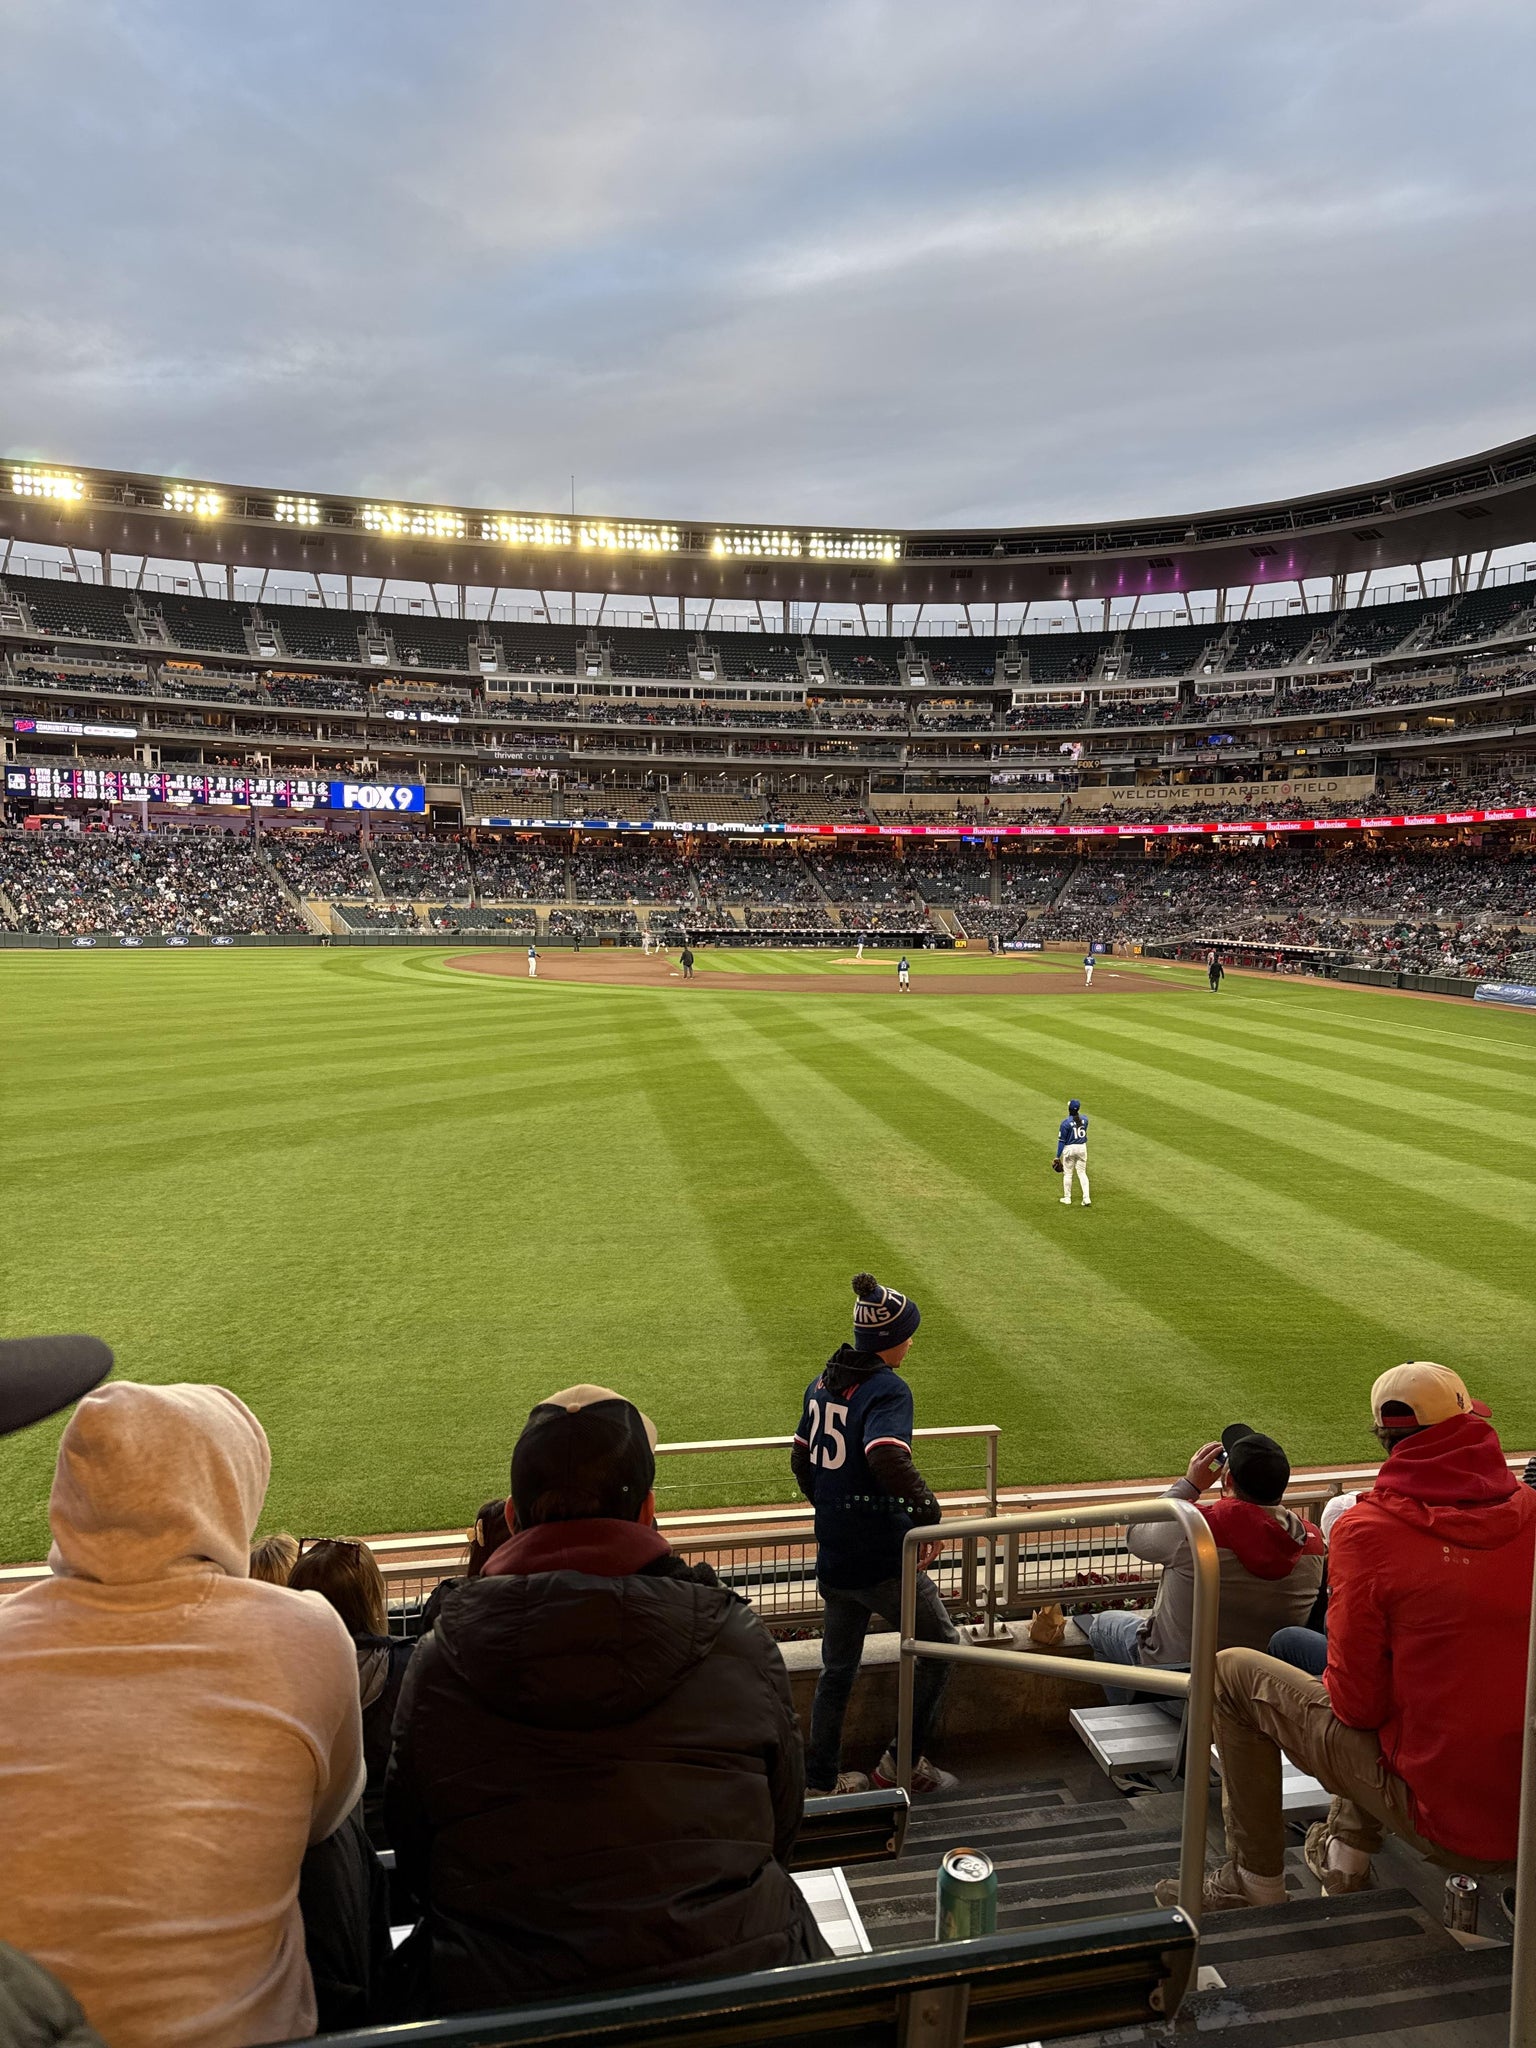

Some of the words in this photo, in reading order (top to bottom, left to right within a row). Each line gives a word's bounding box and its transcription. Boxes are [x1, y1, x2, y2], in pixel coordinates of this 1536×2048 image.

[36, 723, 67, 732] COMMUNITY
[68, 725, 82, 733] FUND
[494, 751, 523, 760] thrivent
[1078, 760, 1094, 768] FOX
[1094, 760, 1100, 768] 9
[1112, 788, 1190, 799] WELCOME
[1195, 787, 1214, 797] TO
[1218, 785, 1279, 796] TARGET
[1293, 782, 1338, 793] FIELD
[343, 785, 395, 809] FOX
[395, 787, 413, 809] 9
[1404, 816, 1436, 824] Budweiser
[1484, 811, 1514, 820] Budweiser
[1266, 823, 1301, 831] Budweiser
[1314, 821, 1348, 829] Budweiser
[1072, 1126, 1086, 1139] 16
[808, 1398, 849, 1470] 25
